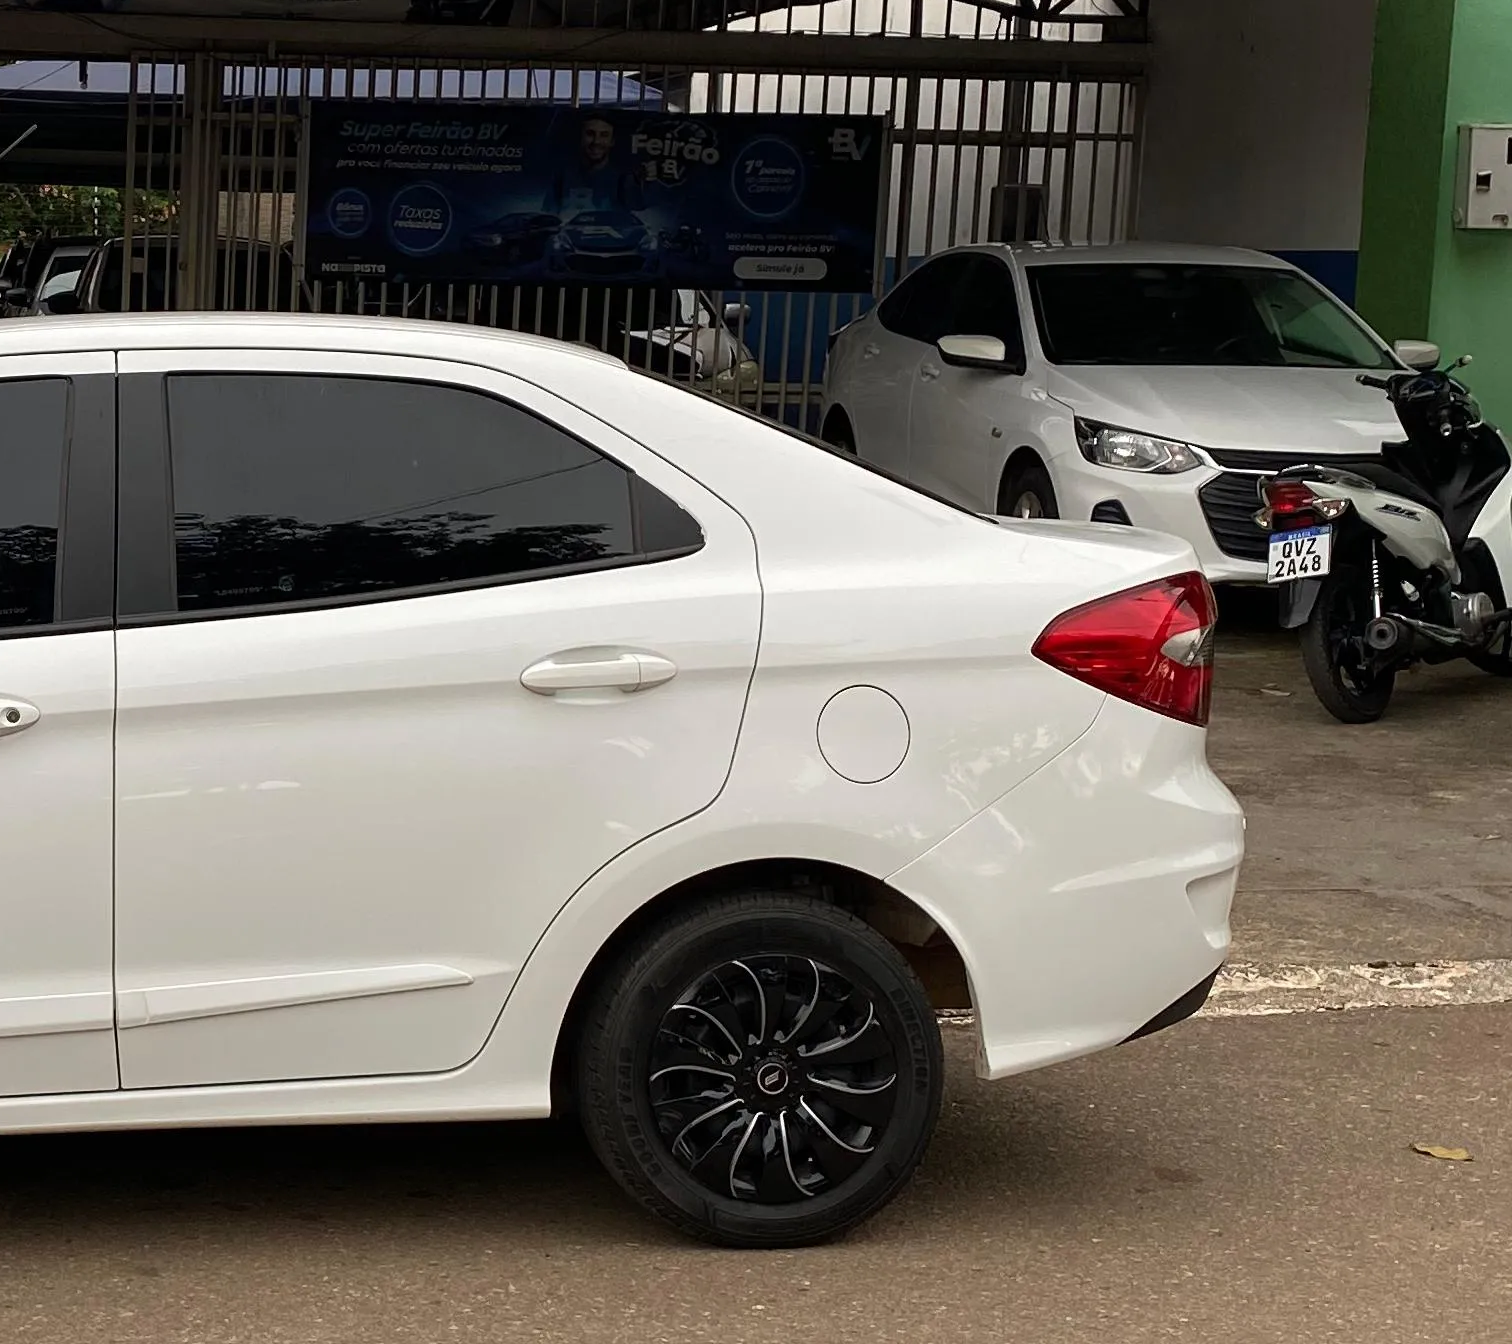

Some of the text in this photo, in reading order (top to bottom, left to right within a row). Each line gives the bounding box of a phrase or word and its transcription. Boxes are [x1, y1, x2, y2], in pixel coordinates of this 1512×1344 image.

[339, 119, 509, 142] Super Feirão BV
[347, 141, 524, 158] com ofertas turbinadas
[631, 132, 720, 165] Feirão
[399, 204, 443, 220] Taxas
[1282, 537, 1317, 559] QVZ
[1274, 554, 1322, 578] 2A48
